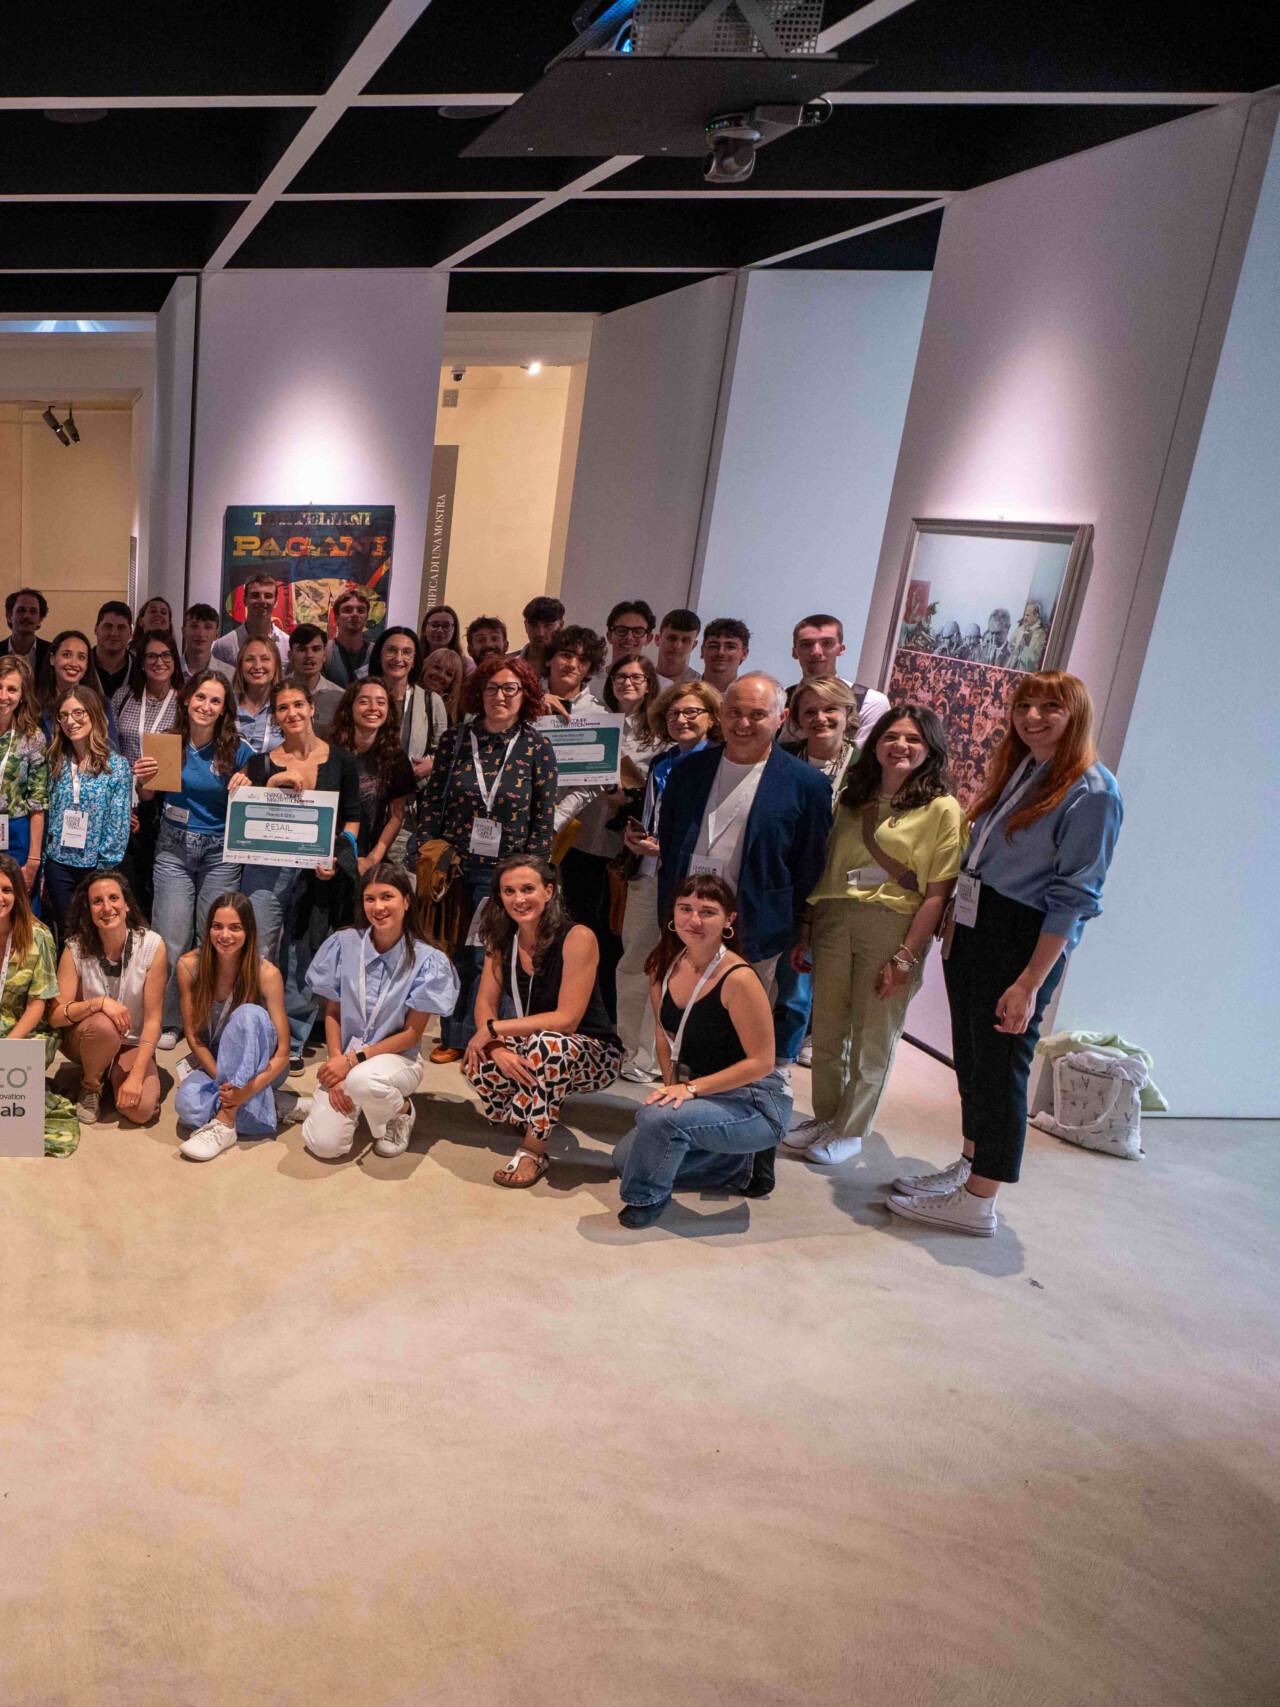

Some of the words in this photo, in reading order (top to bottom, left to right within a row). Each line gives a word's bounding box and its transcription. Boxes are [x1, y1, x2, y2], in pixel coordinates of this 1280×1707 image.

[434, 494, 446, 536] MOSTRA
[432, 538, 442, 559] UNA
[430, 561, 440, 573] DI
[265, 823, 293, 832] RESAIL
